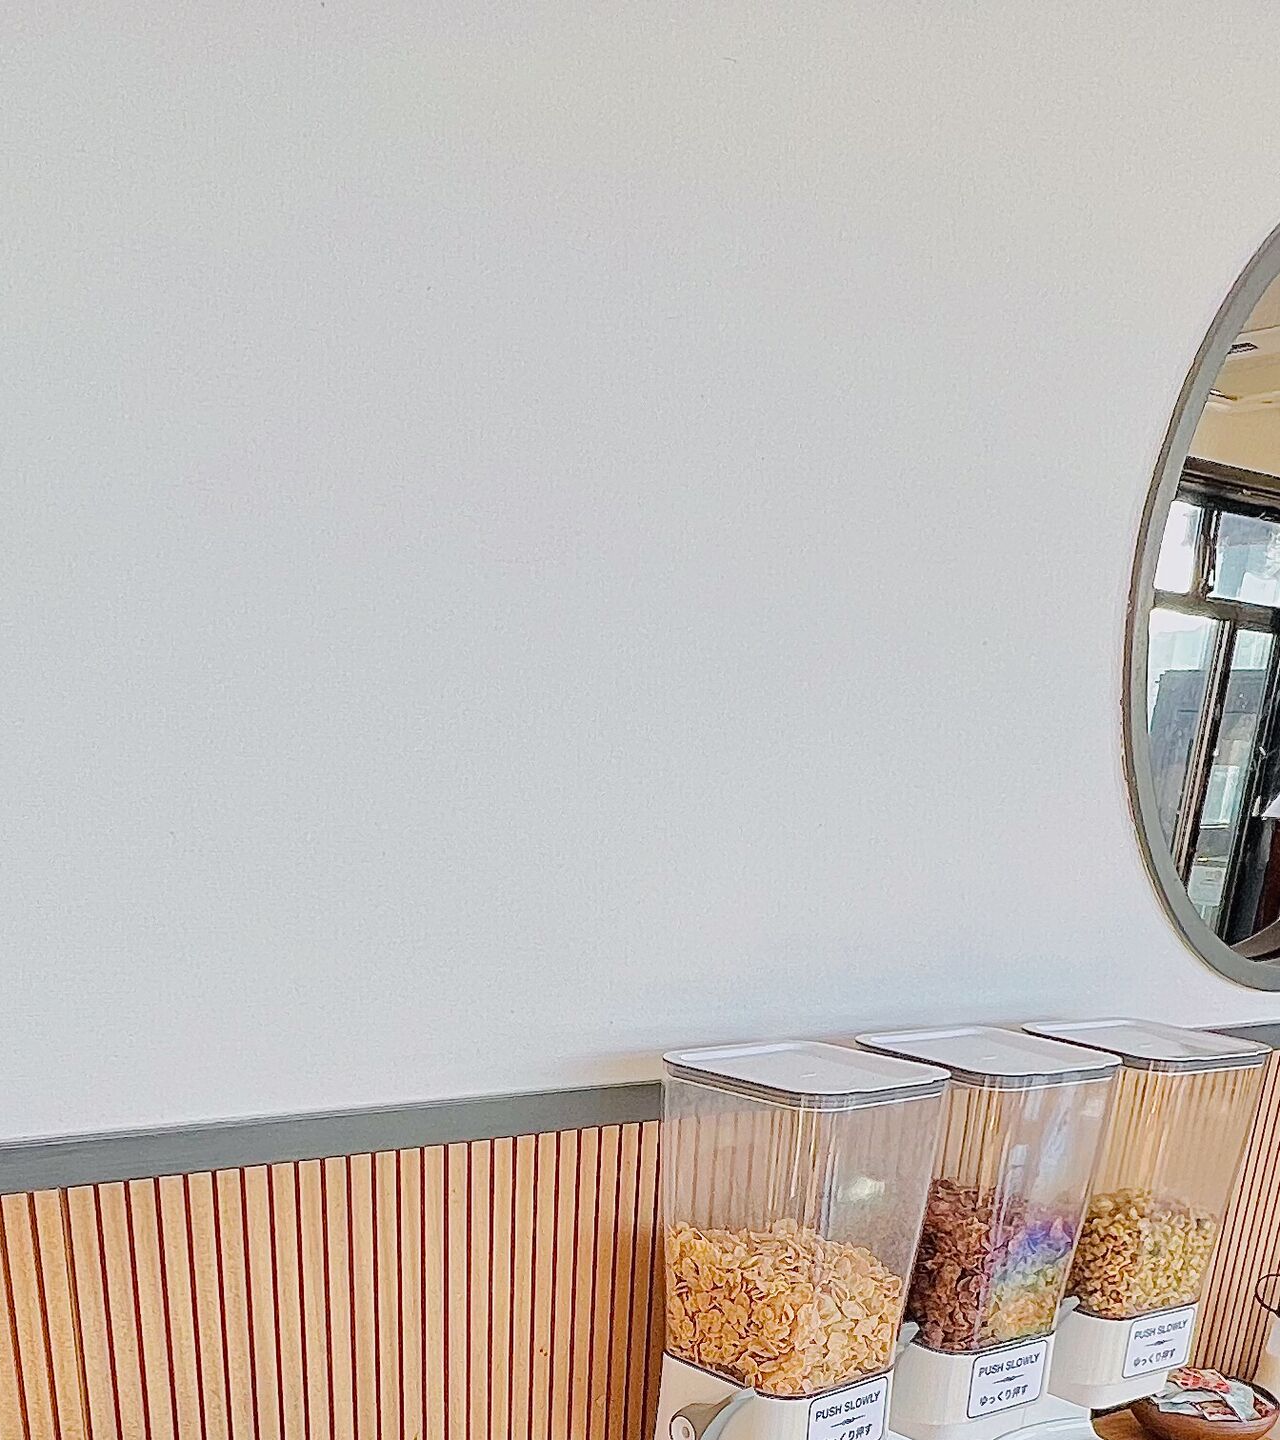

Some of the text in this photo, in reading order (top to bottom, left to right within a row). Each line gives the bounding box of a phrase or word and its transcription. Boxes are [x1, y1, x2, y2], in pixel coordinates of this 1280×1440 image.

[1134, 1318, 1189, 1340] PUSH SLOWLY
[978, 1352, 1041, 1378] PUSH SLOWLY
[815, 1390, 881, 1422] PUSH SLOWLY
[979, 1384, 1029, 1407] ゆっくり押す
